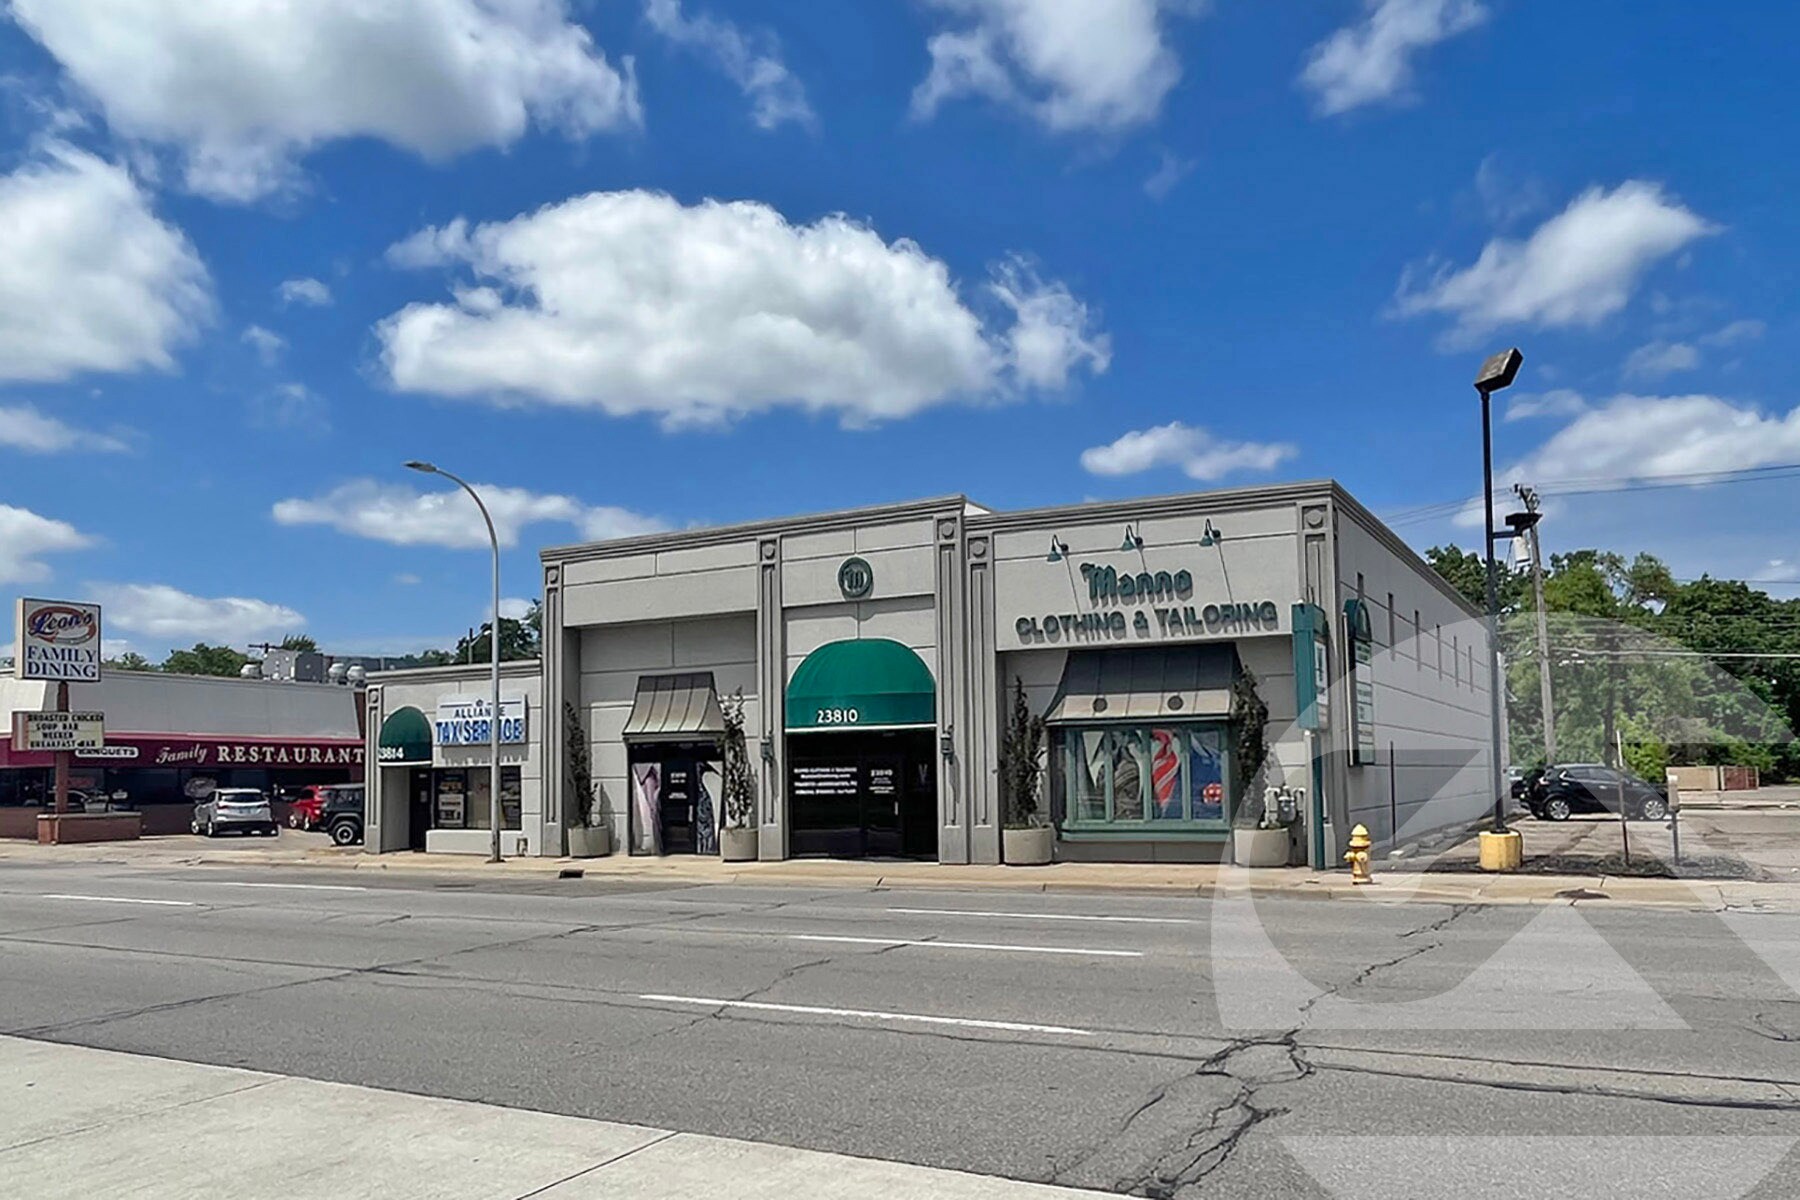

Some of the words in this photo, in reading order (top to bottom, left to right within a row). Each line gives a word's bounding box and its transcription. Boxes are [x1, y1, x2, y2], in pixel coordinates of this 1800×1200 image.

[1080, 562, 1194, 602] Manno
[28, 609, 93, 637] Leon's
[1015, 611, 1127, 640] CLOTHING
[1133, 610, 1149, 633] &
[1154, 601, 1280, 632] TAILORING
[28, 646, 96, 663] FAMILY
[27, 661, 96, 678] DINING
[71, 714, 105, 722] CHICKEN
[454, 706, 506, 719] ALLIANE
[817, 708, 858, 723] 23810
[36, 722, 57, 731] SOUP
[435, 721, 459, 743] TAX
[464, 717, 524, 742] SERICE
[30, 740, 76, 748] BREAKFAST
[78, 748, 136, 756] BANQUETS
[155, 743, 208, 764] Family
[217, 745, 364, 763] RESTAURANT
